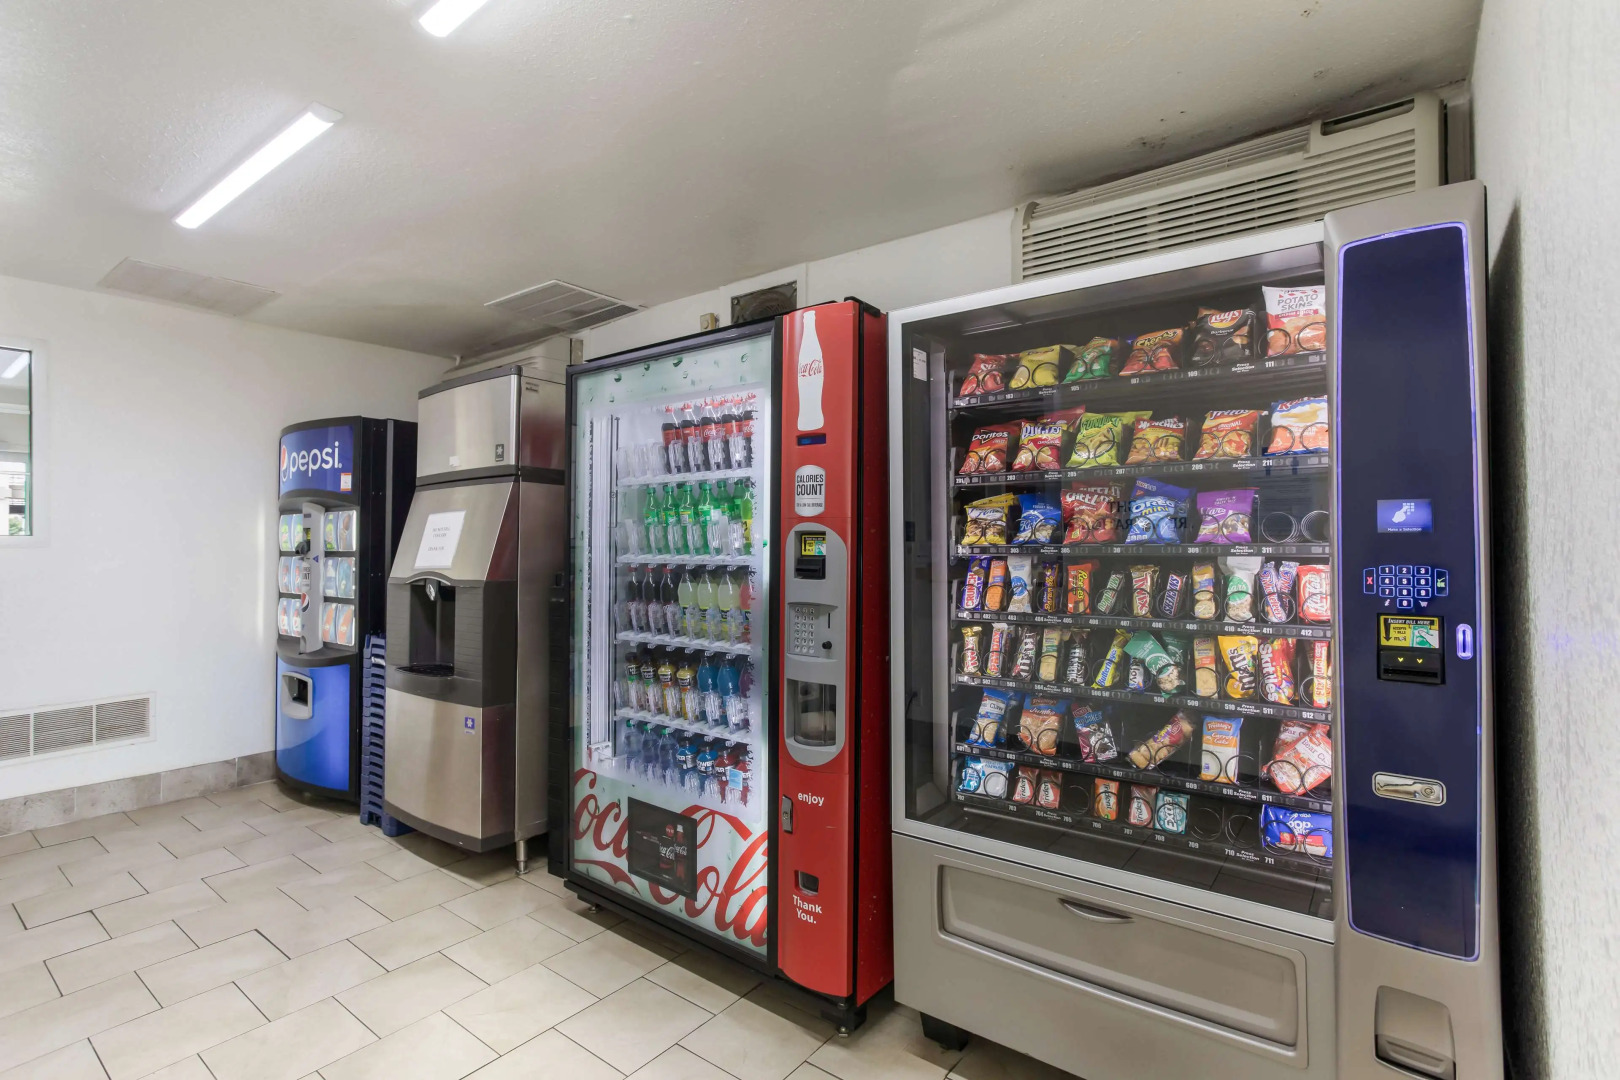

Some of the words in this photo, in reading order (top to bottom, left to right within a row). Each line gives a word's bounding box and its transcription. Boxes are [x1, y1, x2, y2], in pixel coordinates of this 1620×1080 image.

[1278, 294, 1318, 306] POTATO
[1281, 301, 1313, 311] SKINS
[972, 432, 1008, 441] Doritos
[797, 474, 823, 483] CALORIES
[797, 484, 823, 496] COUNT
[1132, 496, 1174, 512] OREO
[1142, 506, 1169, 516] mini
[1134, 572, 1152, 614] TWIX
[1163, 575, 1179, 615] SNICKERS
[1259, 644, 1278, 702] Skittles
[1030, 707, 1055, 715] Jumbo
[1301, 739, 1318, 754] Bear
[798, 793, 824, 806] enjoy
[793, 895, 822, 914] Thank
[796, 909, 816, 924] You.
